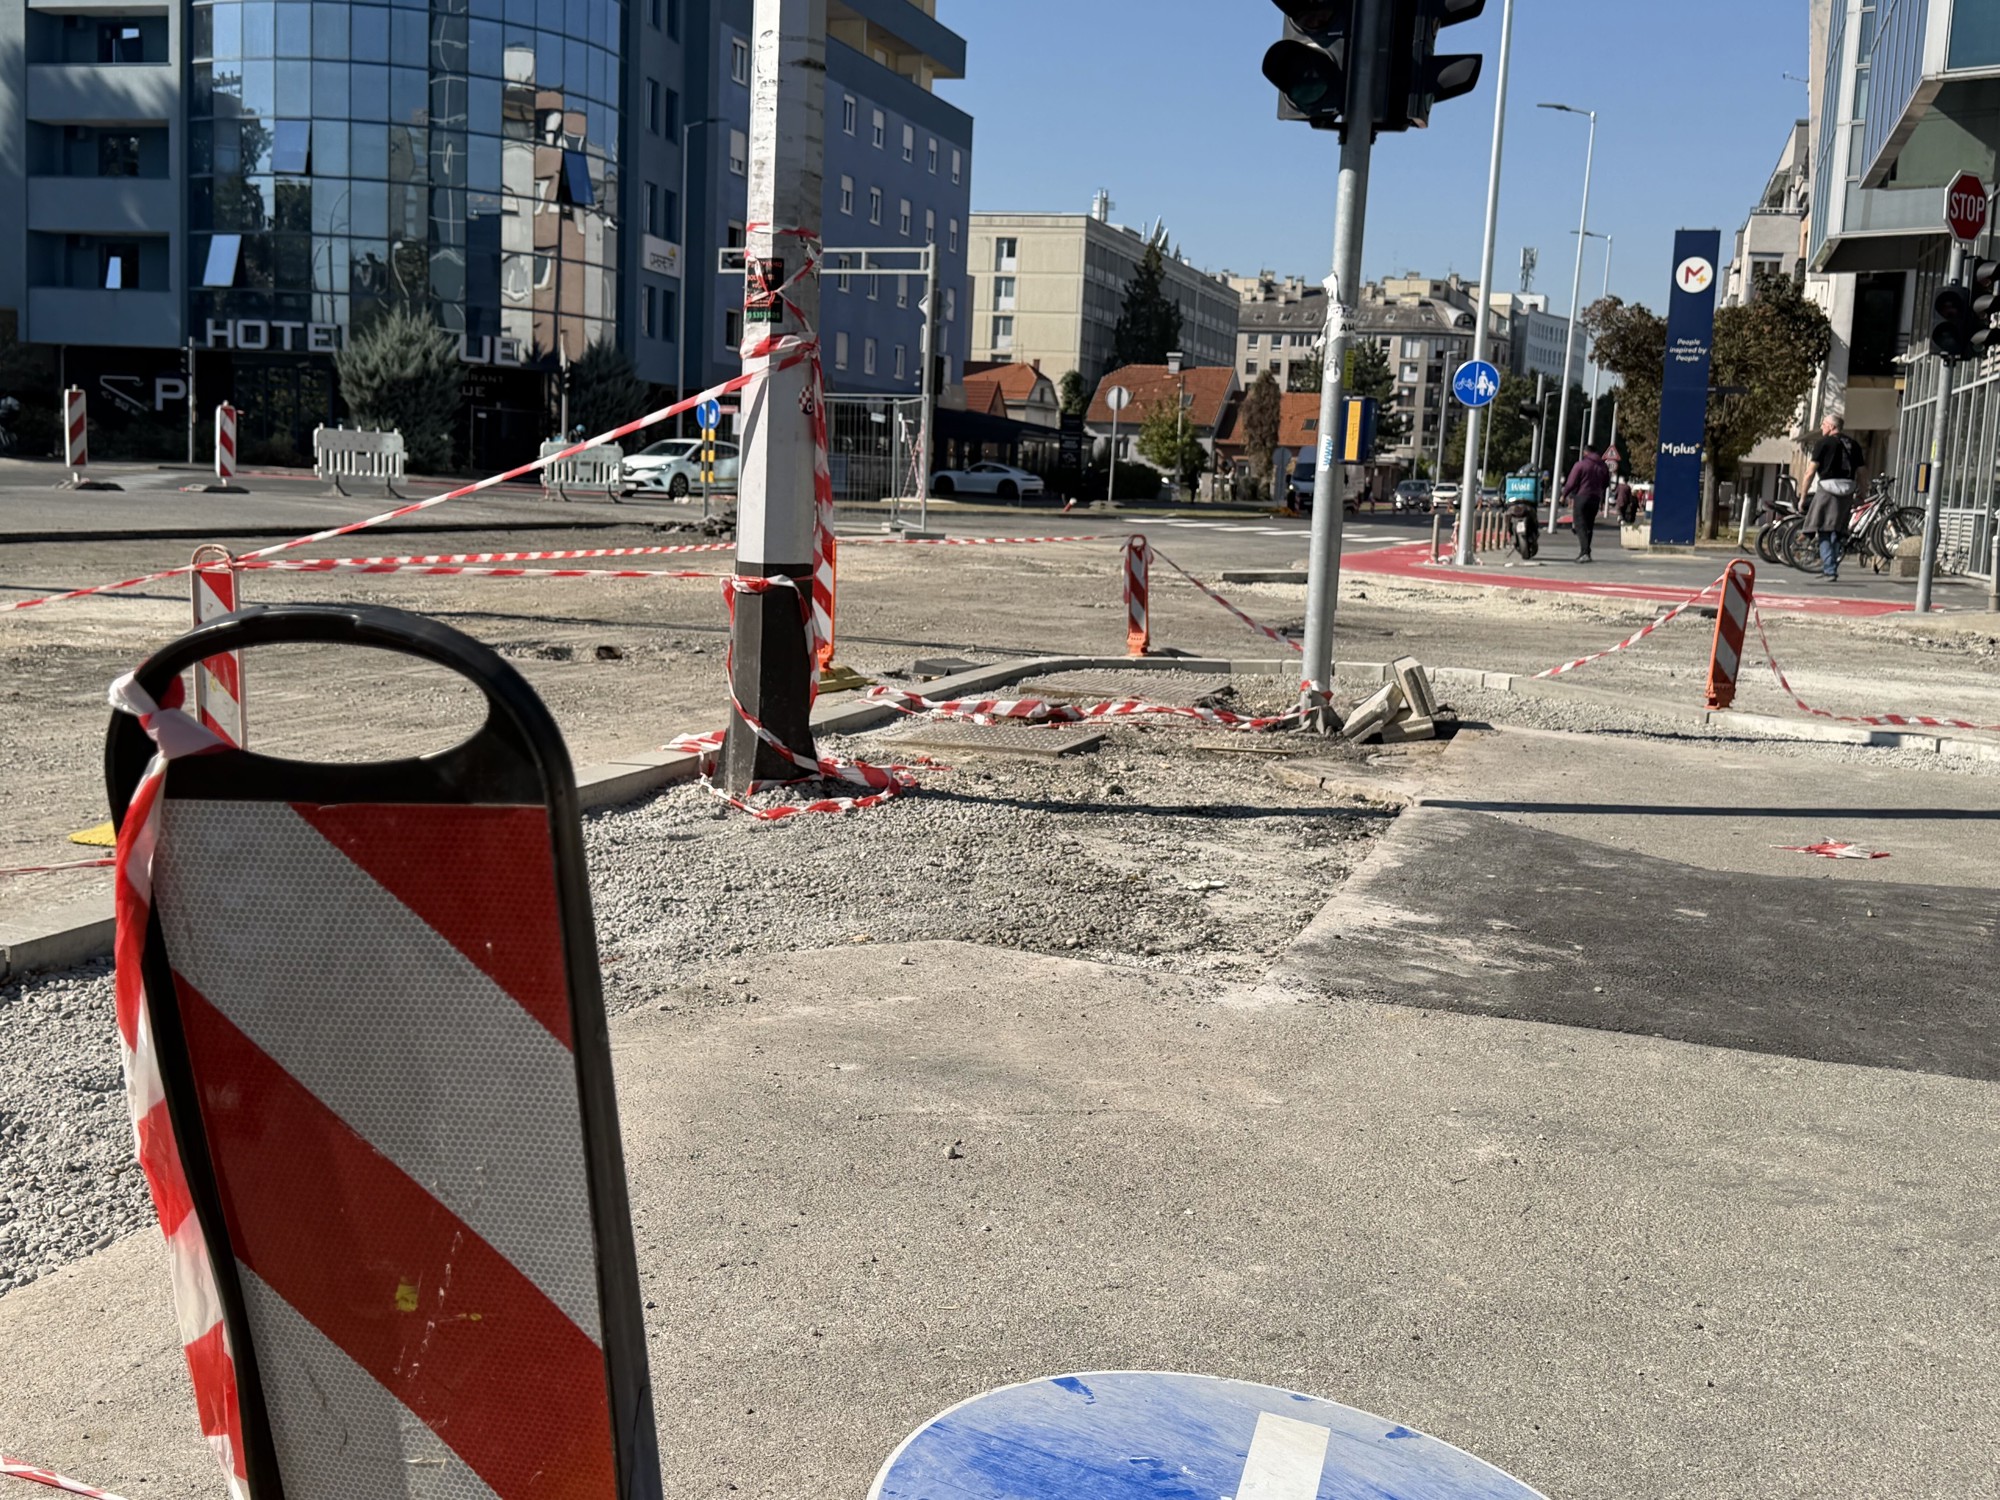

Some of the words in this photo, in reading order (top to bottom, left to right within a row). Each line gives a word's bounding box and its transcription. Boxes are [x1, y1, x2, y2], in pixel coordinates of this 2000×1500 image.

[1950, 192, 1985, 222] STOP
[459, 333, 521, 367] UE
[1669, 346, 1697, 355] inspired
[1698, 346, 1707, 355] by
[1677, 338, 1700, 347] People
[1675, 354, 1699, 363] People
[155, 378, 187, 411] P
